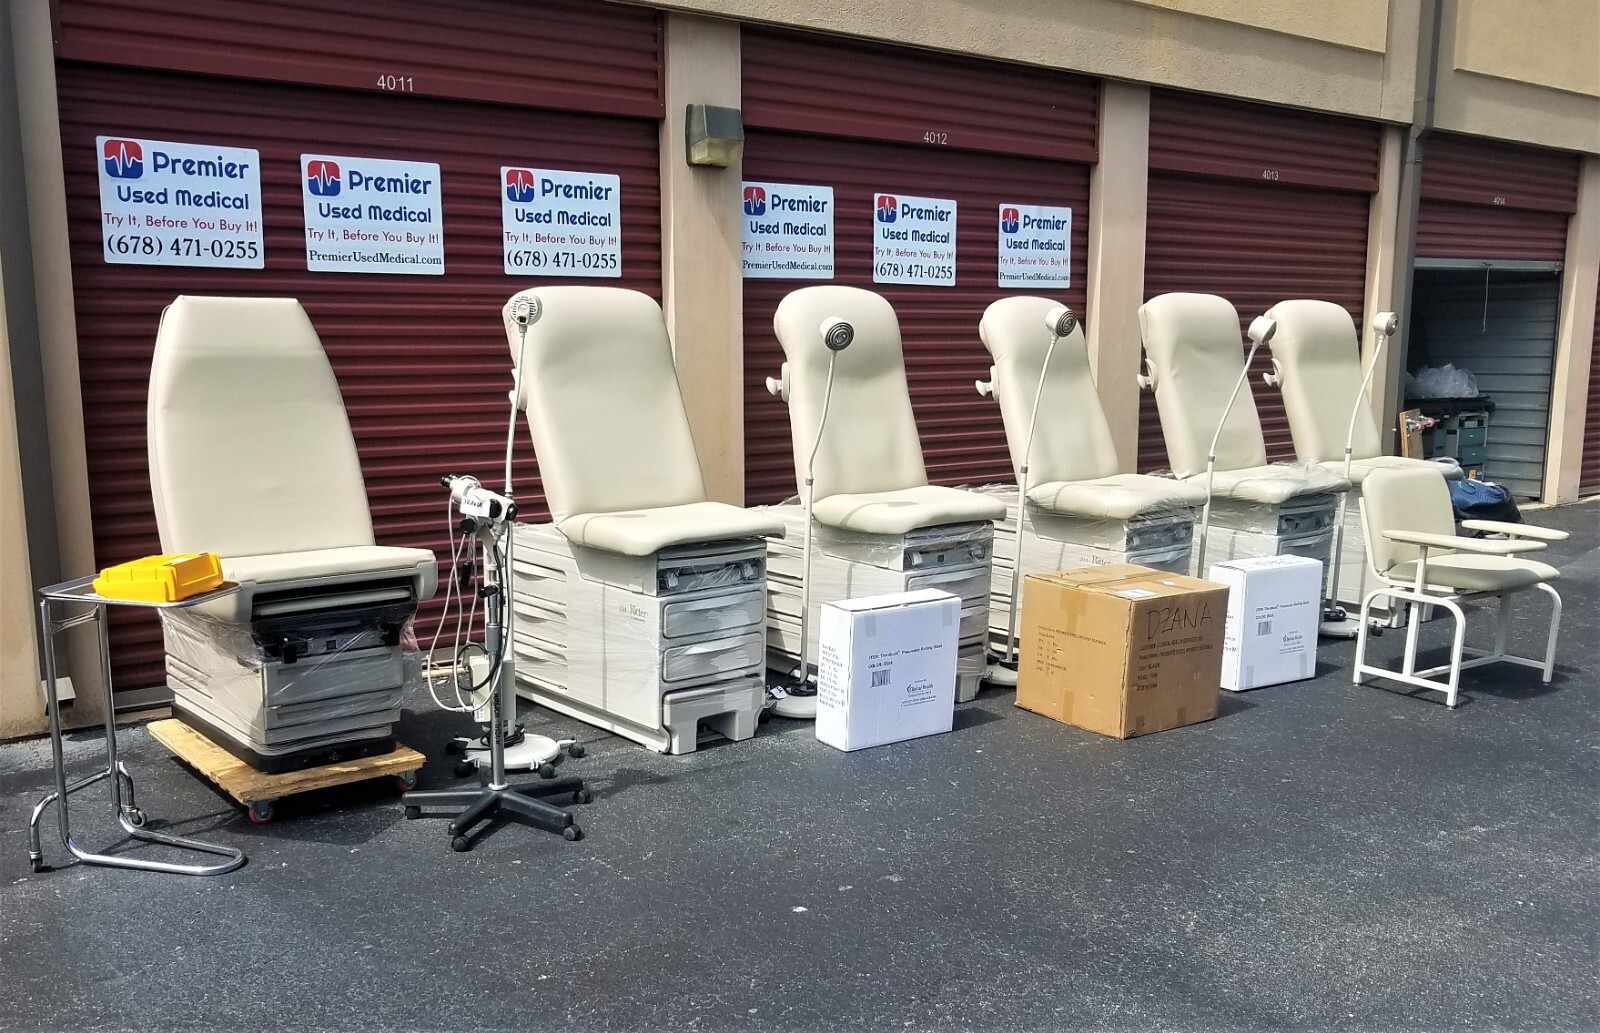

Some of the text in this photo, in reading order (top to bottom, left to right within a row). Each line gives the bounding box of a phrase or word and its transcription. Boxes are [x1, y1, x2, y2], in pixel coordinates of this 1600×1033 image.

[377, 74, 413, 91] 4011
[924, 131, 947, 144] 4012
[153, 152, 249, 179] Premier
[349, 170, 431, 194] Premier
[1262, 169, 1278, 180] 4013
[117, 185, 249, 209] Used Medical
[541, 178, 612, 201] Premier
[772, 194, 827, 212] Premier
[319, 203, 431, 223] Used Medical
[515, 208, 611, 227] Used Medical
[902, 204, 951, 222] Premier
[104, 213, 258, 234] Try It, Before You Buy It!
[750, 221, 826, 236] Used Medical
[1023, 215, 1067, 230] Premier
[308, 228, 439, 245] Try It, Before You Buy It!
[505, 232, 617, 247] Try It, Before You Buy It!
[883, 228, 949, 244] Used Medical
[1007, 238, 1065, 251] Used Medical
[108, 234, 258, 259] (678) 471-0255
[742, 242, 753, 253] Try
[766, 243, 790, 252] Before
[793, 244, 806, 252] You
[809, 244, 822, 255] Buy
[875, 247, 885, 258] Try
[896, 248, 917, 257] Before
[919, 250, 931, 258] You
[934, 251, 945, 260] Buy
[309, 250, 442, 264] PremierUsedMedical.com
[507, 250, 617, 269] (678) 471-0255
[743, 260, 832, 270] PremierUsedMedical.com
[1000, 256, 1008, 266] Try
[1018, 257, 1036, 265] Before
[1051, 258, 1061, 267] Buy
[876, 262, 952, 279] (678) 471-0255
[1000, 272, 1069, 280] PremierUsedMedical.com
